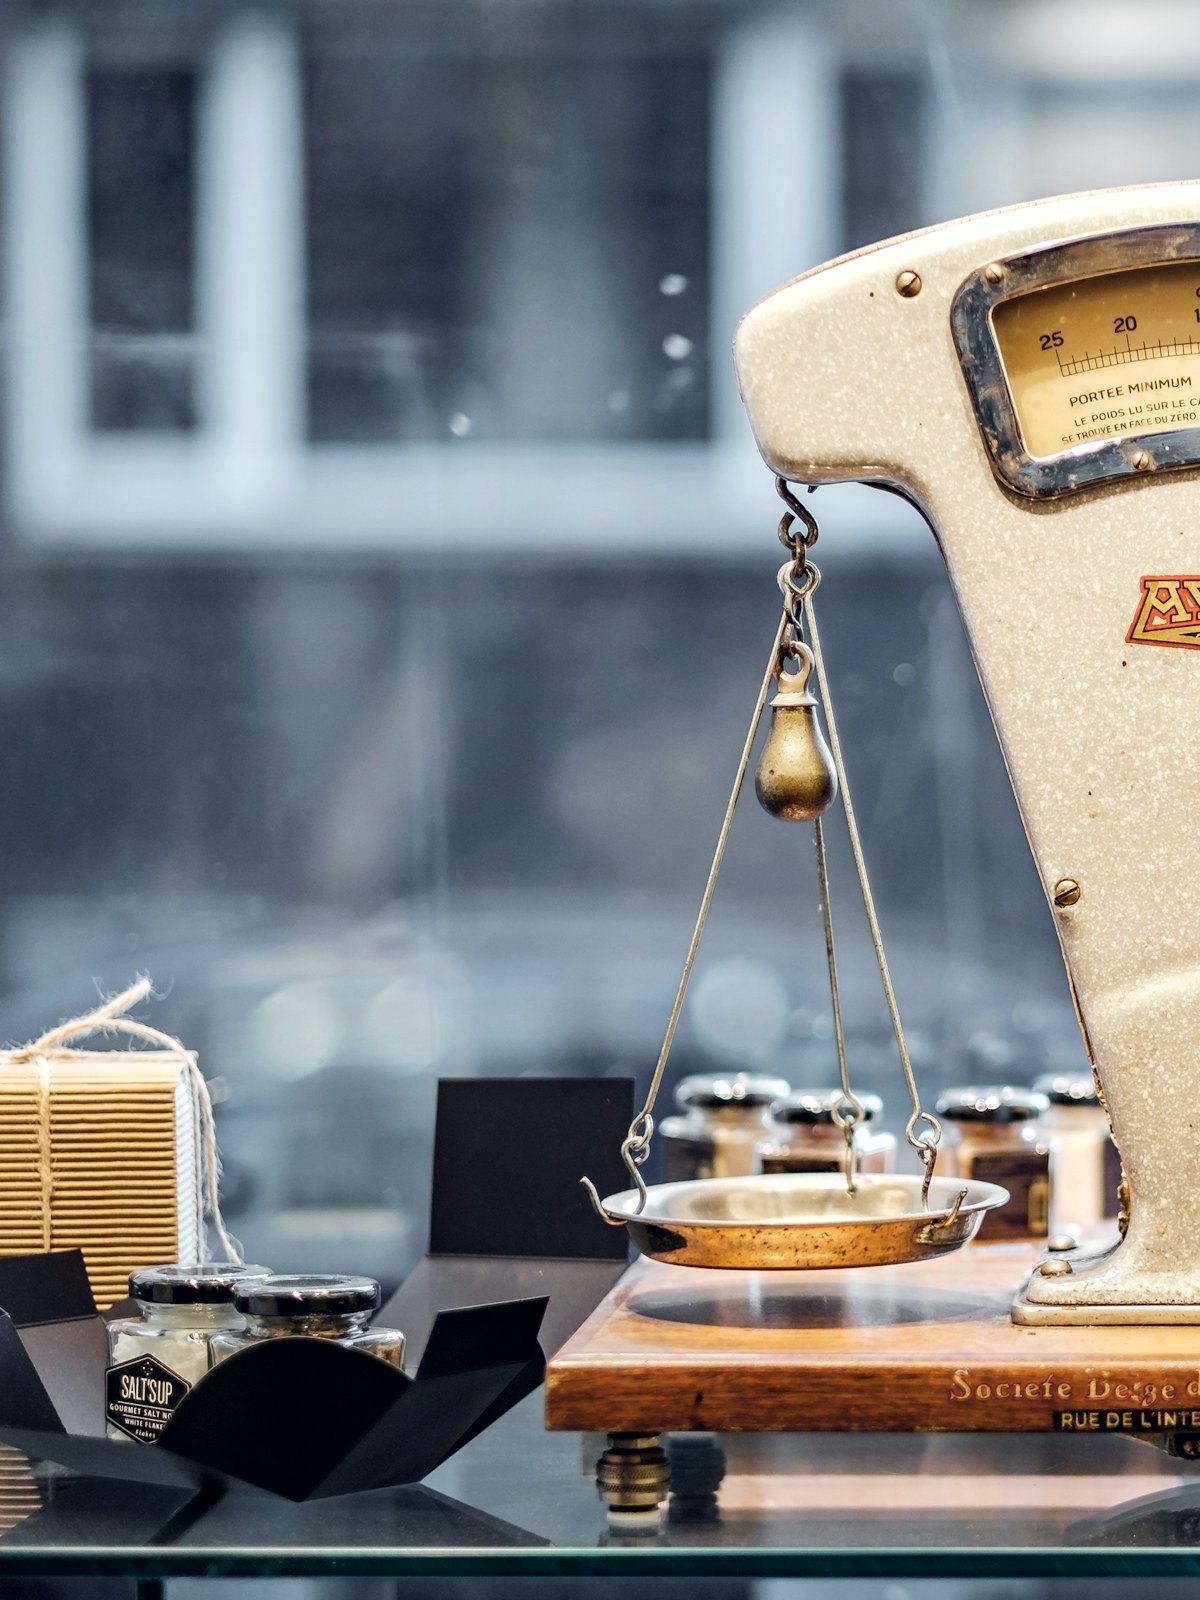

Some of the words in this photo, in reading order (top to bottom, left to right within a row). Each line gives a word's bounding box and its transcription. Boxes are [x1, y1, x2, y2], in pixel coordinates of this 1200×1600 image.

[1039, 331, 1065, 351] 25
[1113, 315, 1138, 334] 20
[1069, 385, 1125, 407] PORTEE
[1128, 376, 1192, 394] MINIMUM
[1074, 416, 1088, 427] LE
[1091, 409, 1126, 423] POIDS
[1128, 405, 1143, 415] LU
[1146, 401, 1169, 412] SUR
[1172, 399, 1186, 409] LE
[1061, 435, 1076, 445] SE
[1076, 425, 1113, 441] TROUVE
[1114, 422, 1127, 432] EN
[1129, 418, 1153, 429] FACE
[1154, 415, 1168, 424] DU
[109, 1403, 142, 1415] GOURMET
[143, 1410, 161, 1418] SALT
[124, 1418, 143, 1427] WHITE
[1061, 1411, 1100, 1428] RUE
[1106, 1411, 1133, 1429] DE
